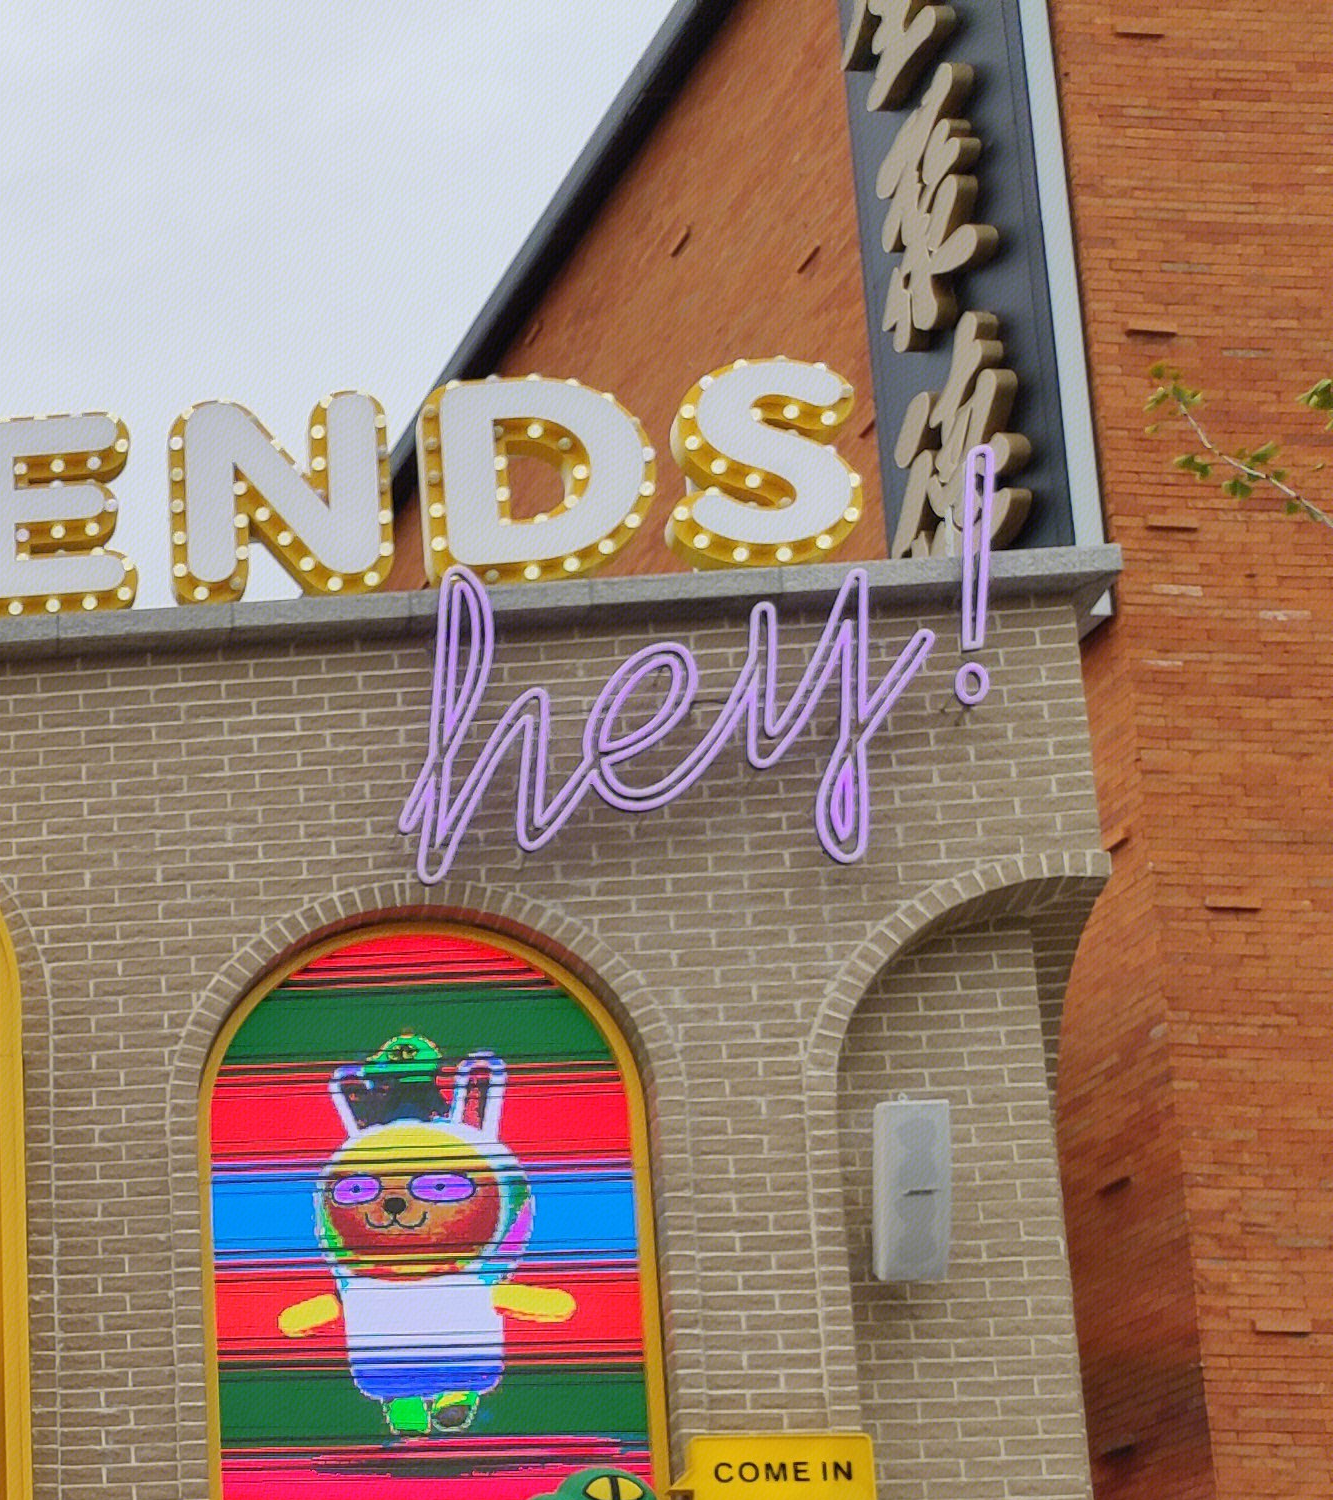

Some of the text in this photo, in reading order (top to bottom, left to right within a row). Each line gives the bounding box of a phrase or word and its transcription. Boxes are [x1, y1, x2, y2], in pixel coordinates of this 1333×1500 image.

[398, 445, 996, 885] hey!
[714, 1460, 854, 1484] COME IN
